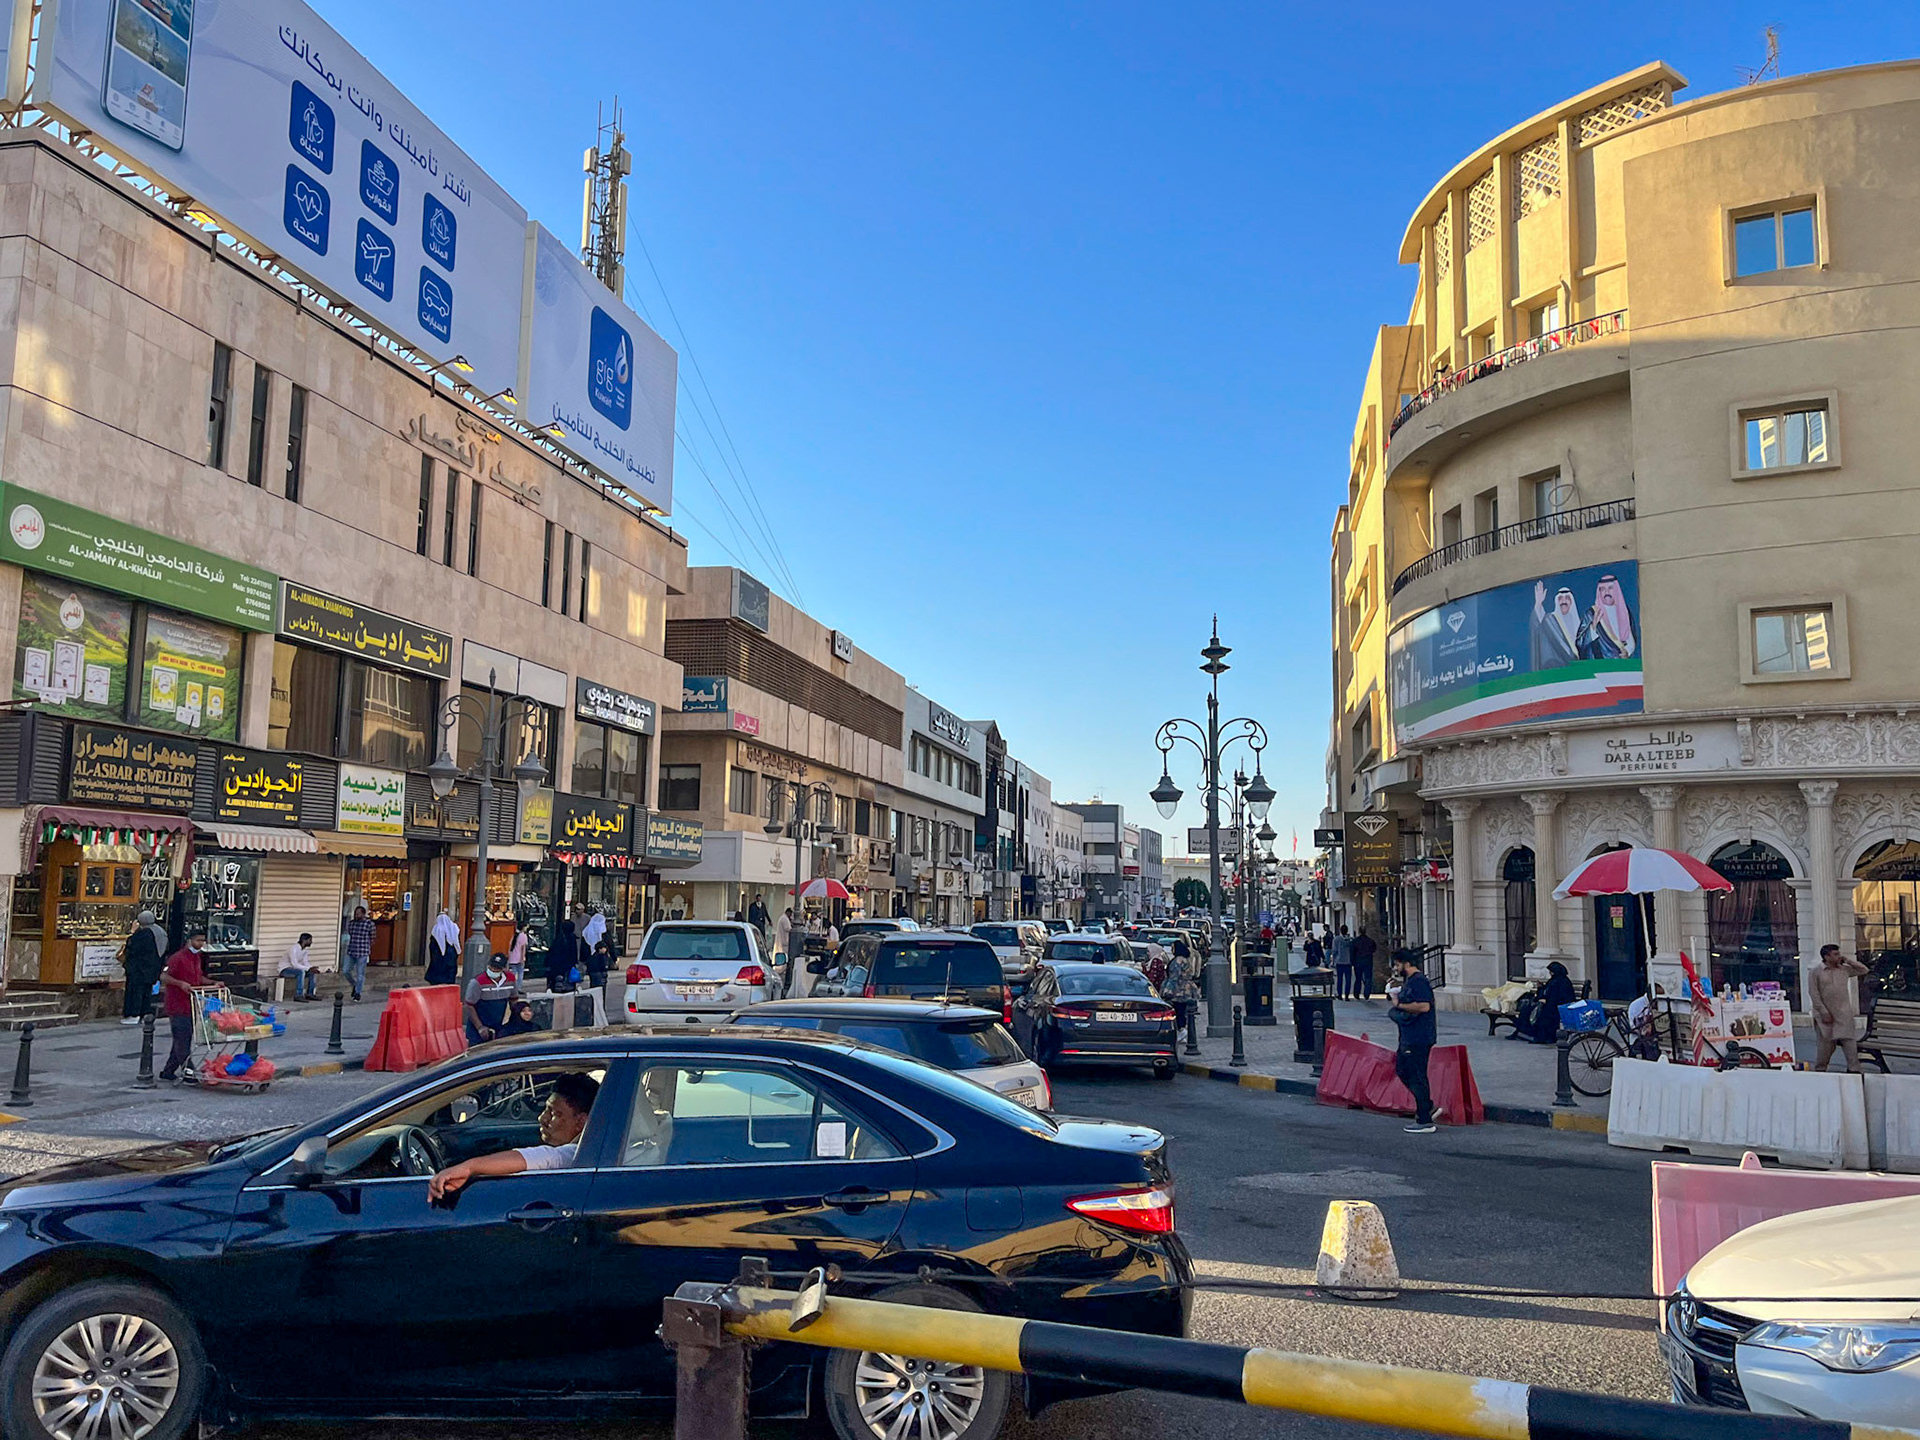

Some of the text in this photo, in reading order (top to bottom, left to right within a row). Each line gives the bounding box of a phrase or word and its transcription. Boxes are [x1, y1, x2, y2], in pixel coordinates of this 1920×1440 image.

[279, 25, 471, 207] اشتر تأمينك وانت بمكانك
[300, 136, 324, 161] الحياة
[366, 188, 391, 214] القوارب
[293, 217, 320, 245] الصحة
[429, 241, 448, 260] المنزل
[363, 272, 385, 292] السفر
[422, 310, 447, 335] السيارات
[595, 358, 614, 392] gig
[552, 402, 656, 484] تطبيق الخليج للتأمين
[68, 544, 117, 566] AL-JAMAIY
[94, 536, 225, 583] شركة الجامعي الخليجي
[288, 615, 323, 638] والألماس
[354, 621, 448, 668] الجوادين
[1464, 659, 1476, 676] الله
[1477, 654, 1514, 677] وفقكم
[586, 687, 652, 718] مجوهرات رضوي
[75, 733, 196, 771] مجوهرات الأسرار
[1605, 749, 1695, 763] DAR ALTEEB
[73, 760, 195, 787] AL-ASRAR JEWELLERY
[1621, 762, 1678, 771] PERFUMES
[225, 767, 302, 800] الجوادين
[565, 809, 624, 840] الجوادين
